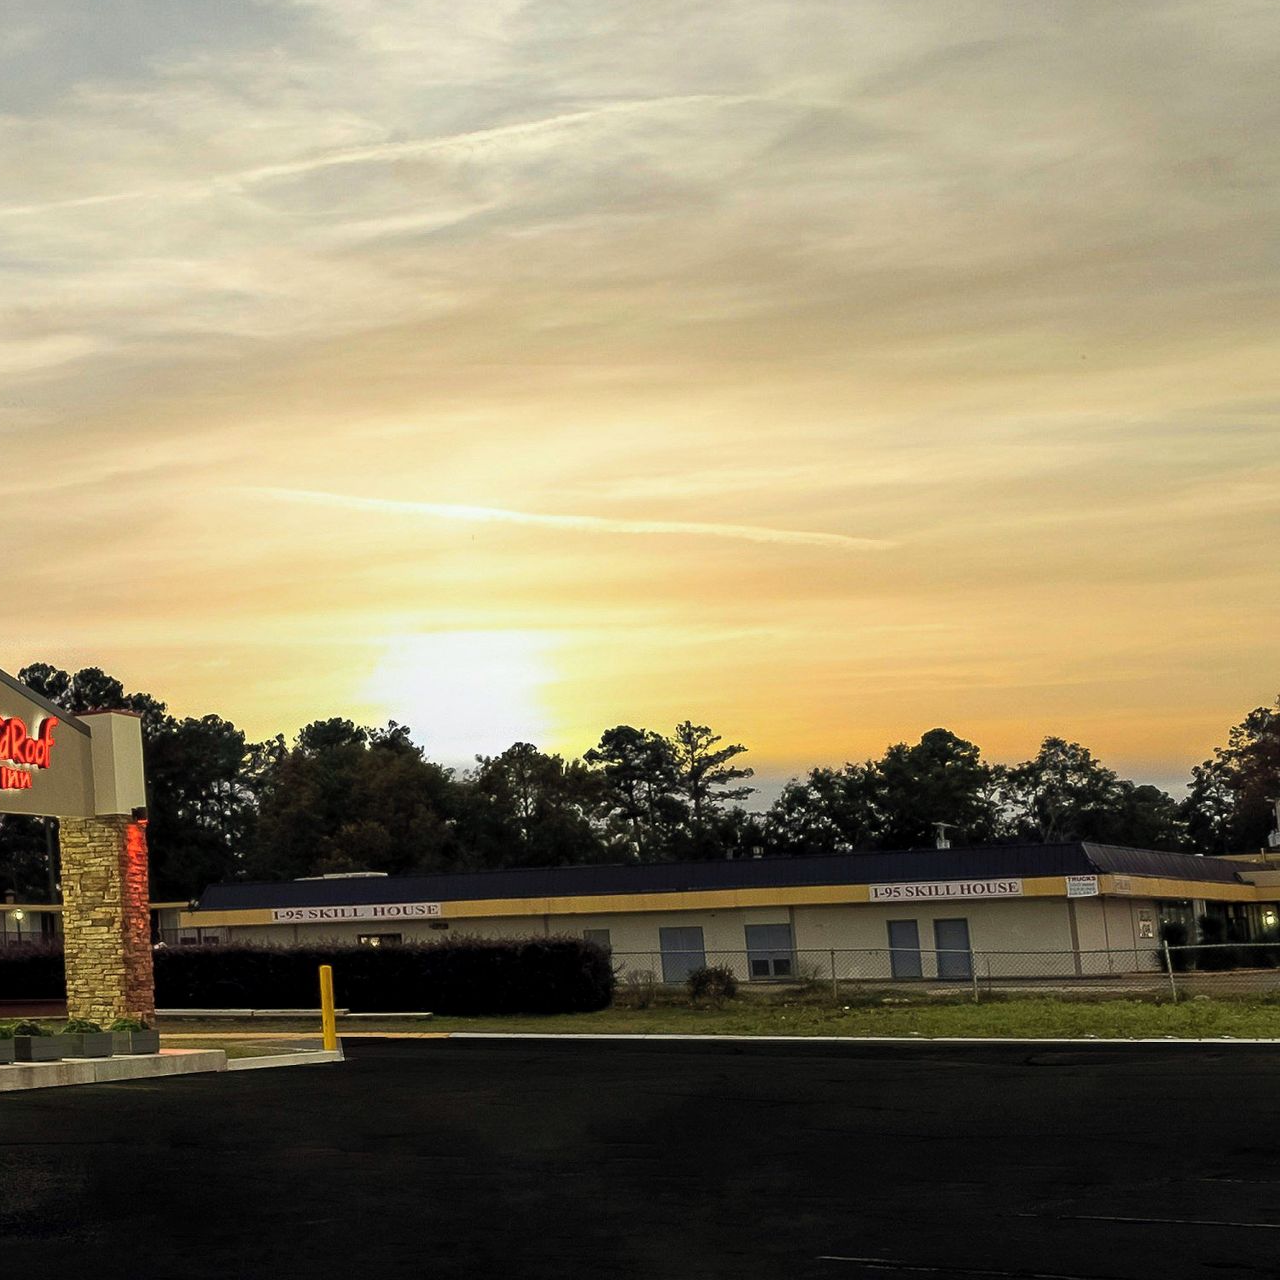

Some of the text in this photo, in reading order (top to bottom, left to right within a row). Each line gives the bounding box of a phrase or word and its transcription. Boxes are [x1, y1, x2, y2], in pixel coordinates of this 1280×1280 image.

[873, 881, 1019, 898] I-95 SKILL HOUSE
[274, 904, 439, 920] I-95 SKILL HOUSE
